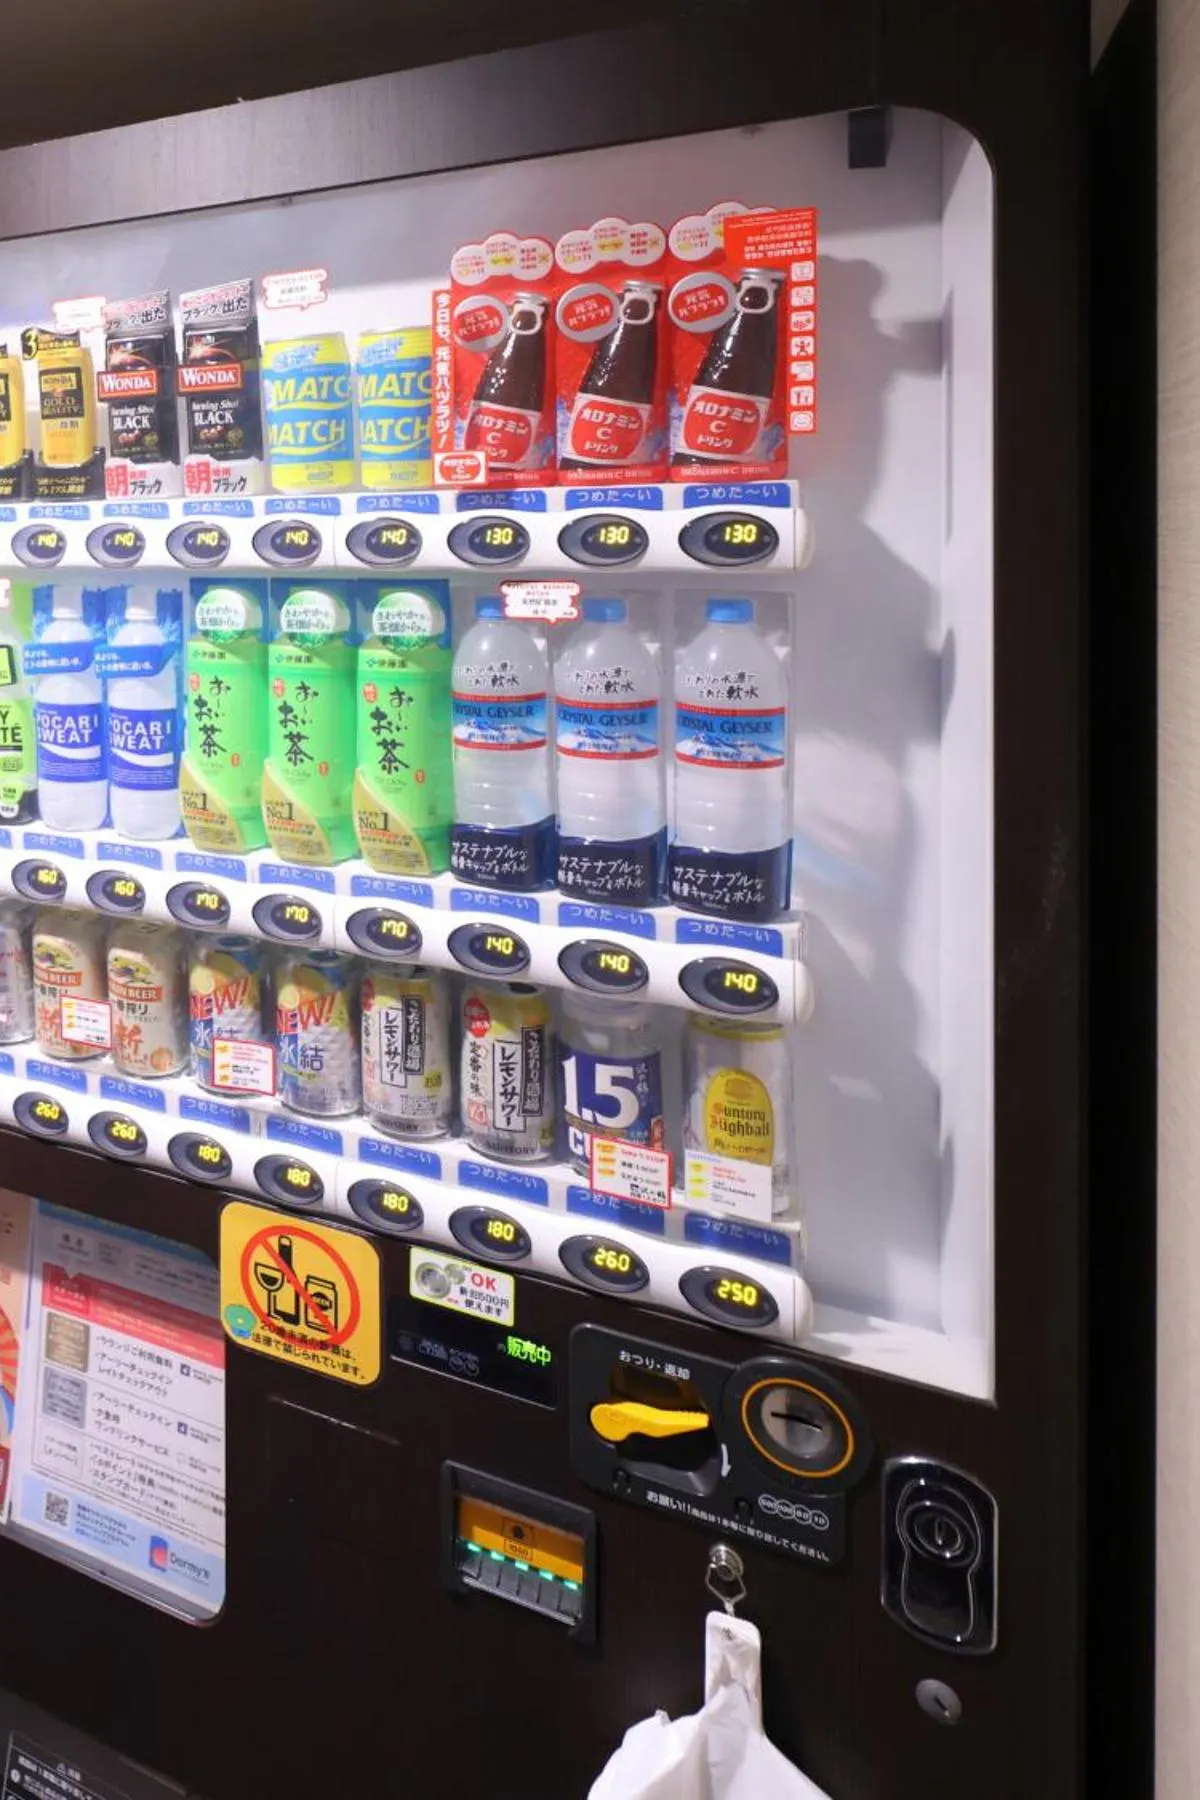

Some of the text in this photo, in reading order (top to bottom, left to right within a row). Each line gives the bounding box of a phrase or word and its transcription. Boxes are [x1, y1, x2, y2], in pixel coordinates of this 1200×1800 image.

[22, 328, 38, 360] 3
[102, 373, 152, 392] WONDA
[183, 365, 236, 386] WONDA
[581, 407, 640, 428] オロナミン
[693, 400, 757, 423] オロナミン
[473, 414, 529, 434] オロナミン
[596, 427, 612, 439] C
[709, 420, 726, 433] C
[486, 432, 502, 444] C
[130, 479, 162, 495] ブラック
[213, 477, 247, 493] ブラック
[200, 533, 217, 544] 140
[287, 531, 308, 544] 140
[384, 529, 405, 544] 140
[488, 527, 513, 544] 130
[600, 526, 629, 544] 130
[725, 524, 757, 543] 130
[487, 705, 535, 719] GEYSER
[600, 712, 649, 727] GEYSER
[719, 721, 773, 734] GEYSER
[198, 894, 219, 908] 170
[285, 907, 309, 922] 170
[382, 921, 407, 938] 170
[486, 937, 513, 955] 140
[600, 954, 630, 973] 140
[725, 972, 757, 993] 140
[279, 1036, 325, 1072] 氷結
[383, 1010, 400, 1083] レモンサワー
[498, 1046, 520, 1128] レモンサワー
[562, 1055, 640, 1129] 1.5
[198, 1145, 221, 1162] 180
[287, 1168, 311, 1187] 180
[383, 1193, 409, 1212] 180
[487, 1221, 514, 1241] 180
[594, 1248, 630, 1272] 260
[471, 1272, 497, 1293] OK
[717, 1279, 757, 1306] 250
[507, 1335, 552, 1367] 販売中
